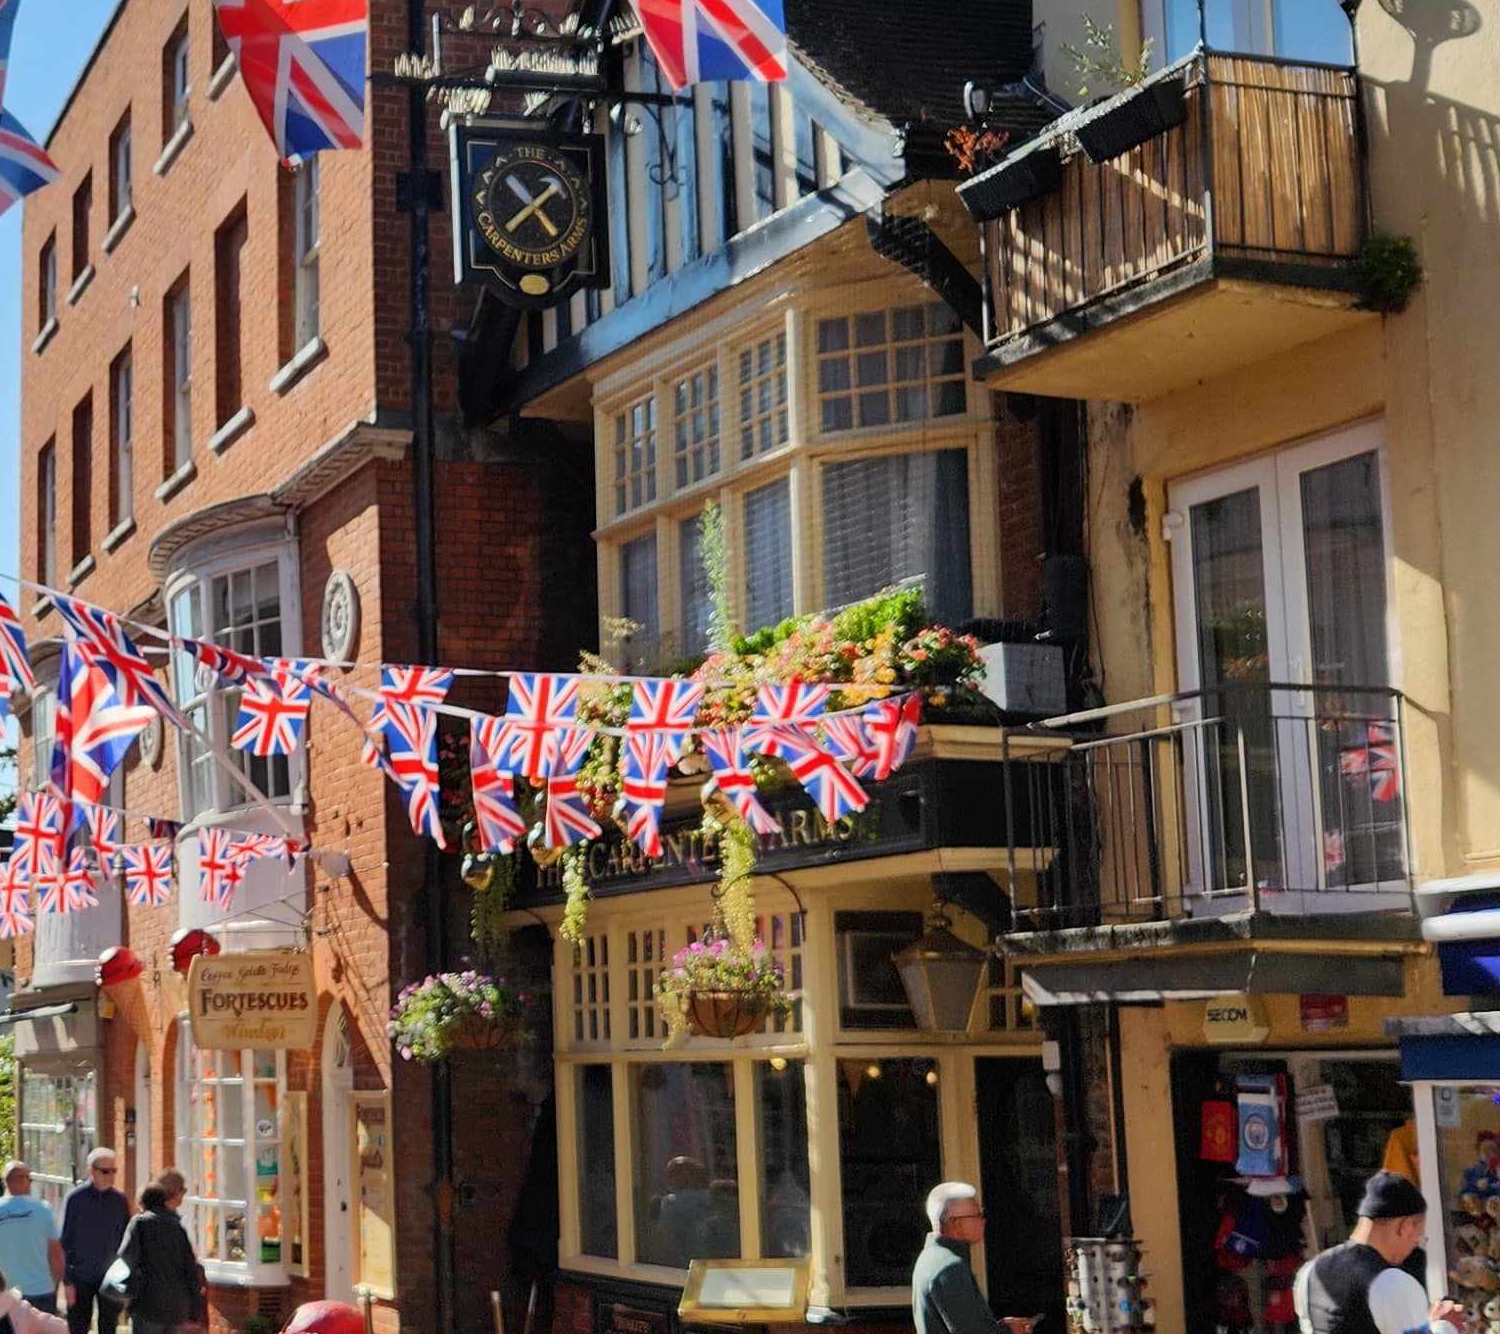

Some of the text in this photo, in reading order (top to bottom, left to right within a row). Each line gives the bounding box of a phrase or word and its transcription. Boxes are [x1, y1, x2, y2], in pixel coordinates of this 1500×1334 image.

[514, 146, 546, 160] THE
[477, 211, 588, 266] CARPENTERS ARMS
